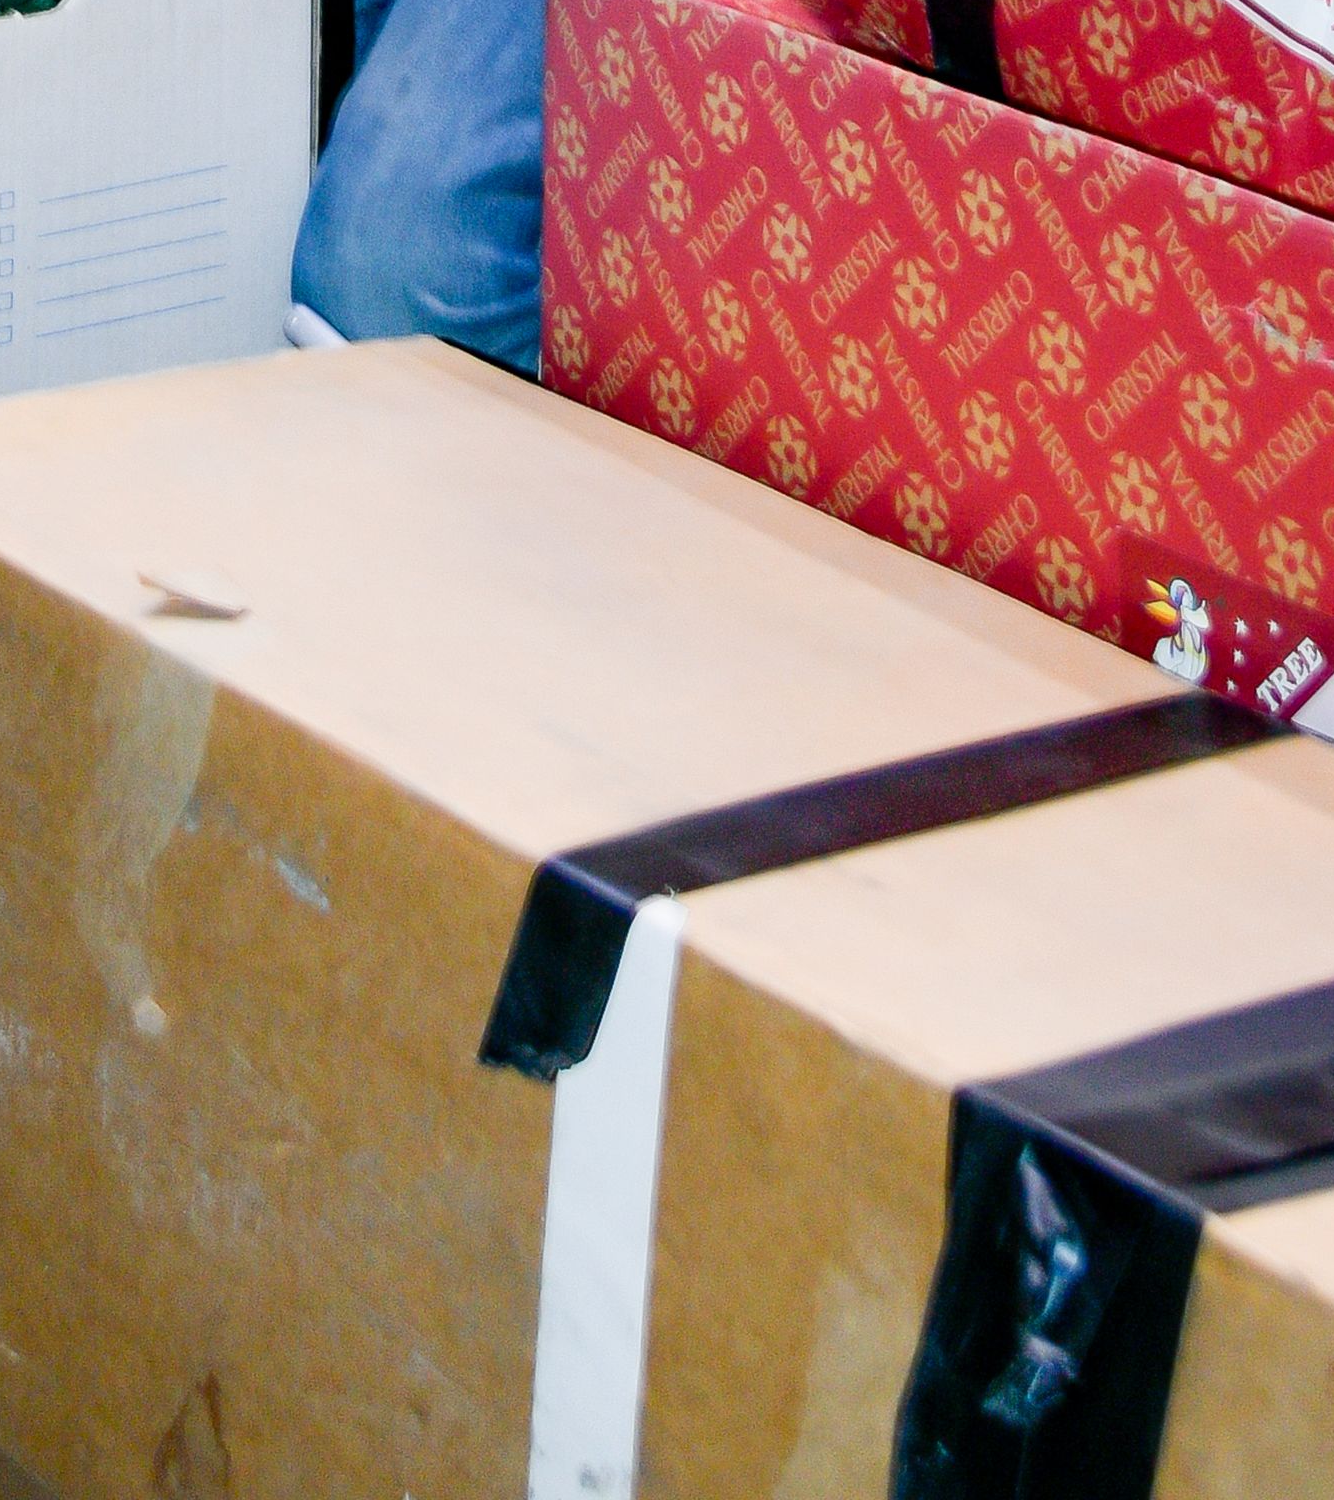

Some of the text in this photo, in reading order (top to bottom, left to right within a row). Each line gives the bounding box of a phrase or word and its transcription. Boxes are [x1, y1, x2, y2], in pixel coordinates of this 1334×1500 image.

[632, 12, 705, 170] CHRISTAL
[752, 60, 832, 221] CHRISTAL
[1122, 50, 1230, 126] CHRISTAL
[586, 122, 655, 219] CHRISTAL
[686, 166, 767, 270] CHRISTAL
[875, 106, 961, 272] CHRISTAL
[1013, 157, 1108, 331] CHRISTAL
[634, 217, 707, 375] CHRISTAL
[750, 268, 835, 435] CHRISTAL
[810, 219, 899, 326] CHRISTAL
[940, 269, 1034, 377] CHRISTAL
[875, 320, 963, 491] CHRISTAL
[1084, 330, 1187, 442] CHRISTAL
[1015, 381, 1116, 558] CHRISTAL
[1255, 636, 1326, 713] TREE
